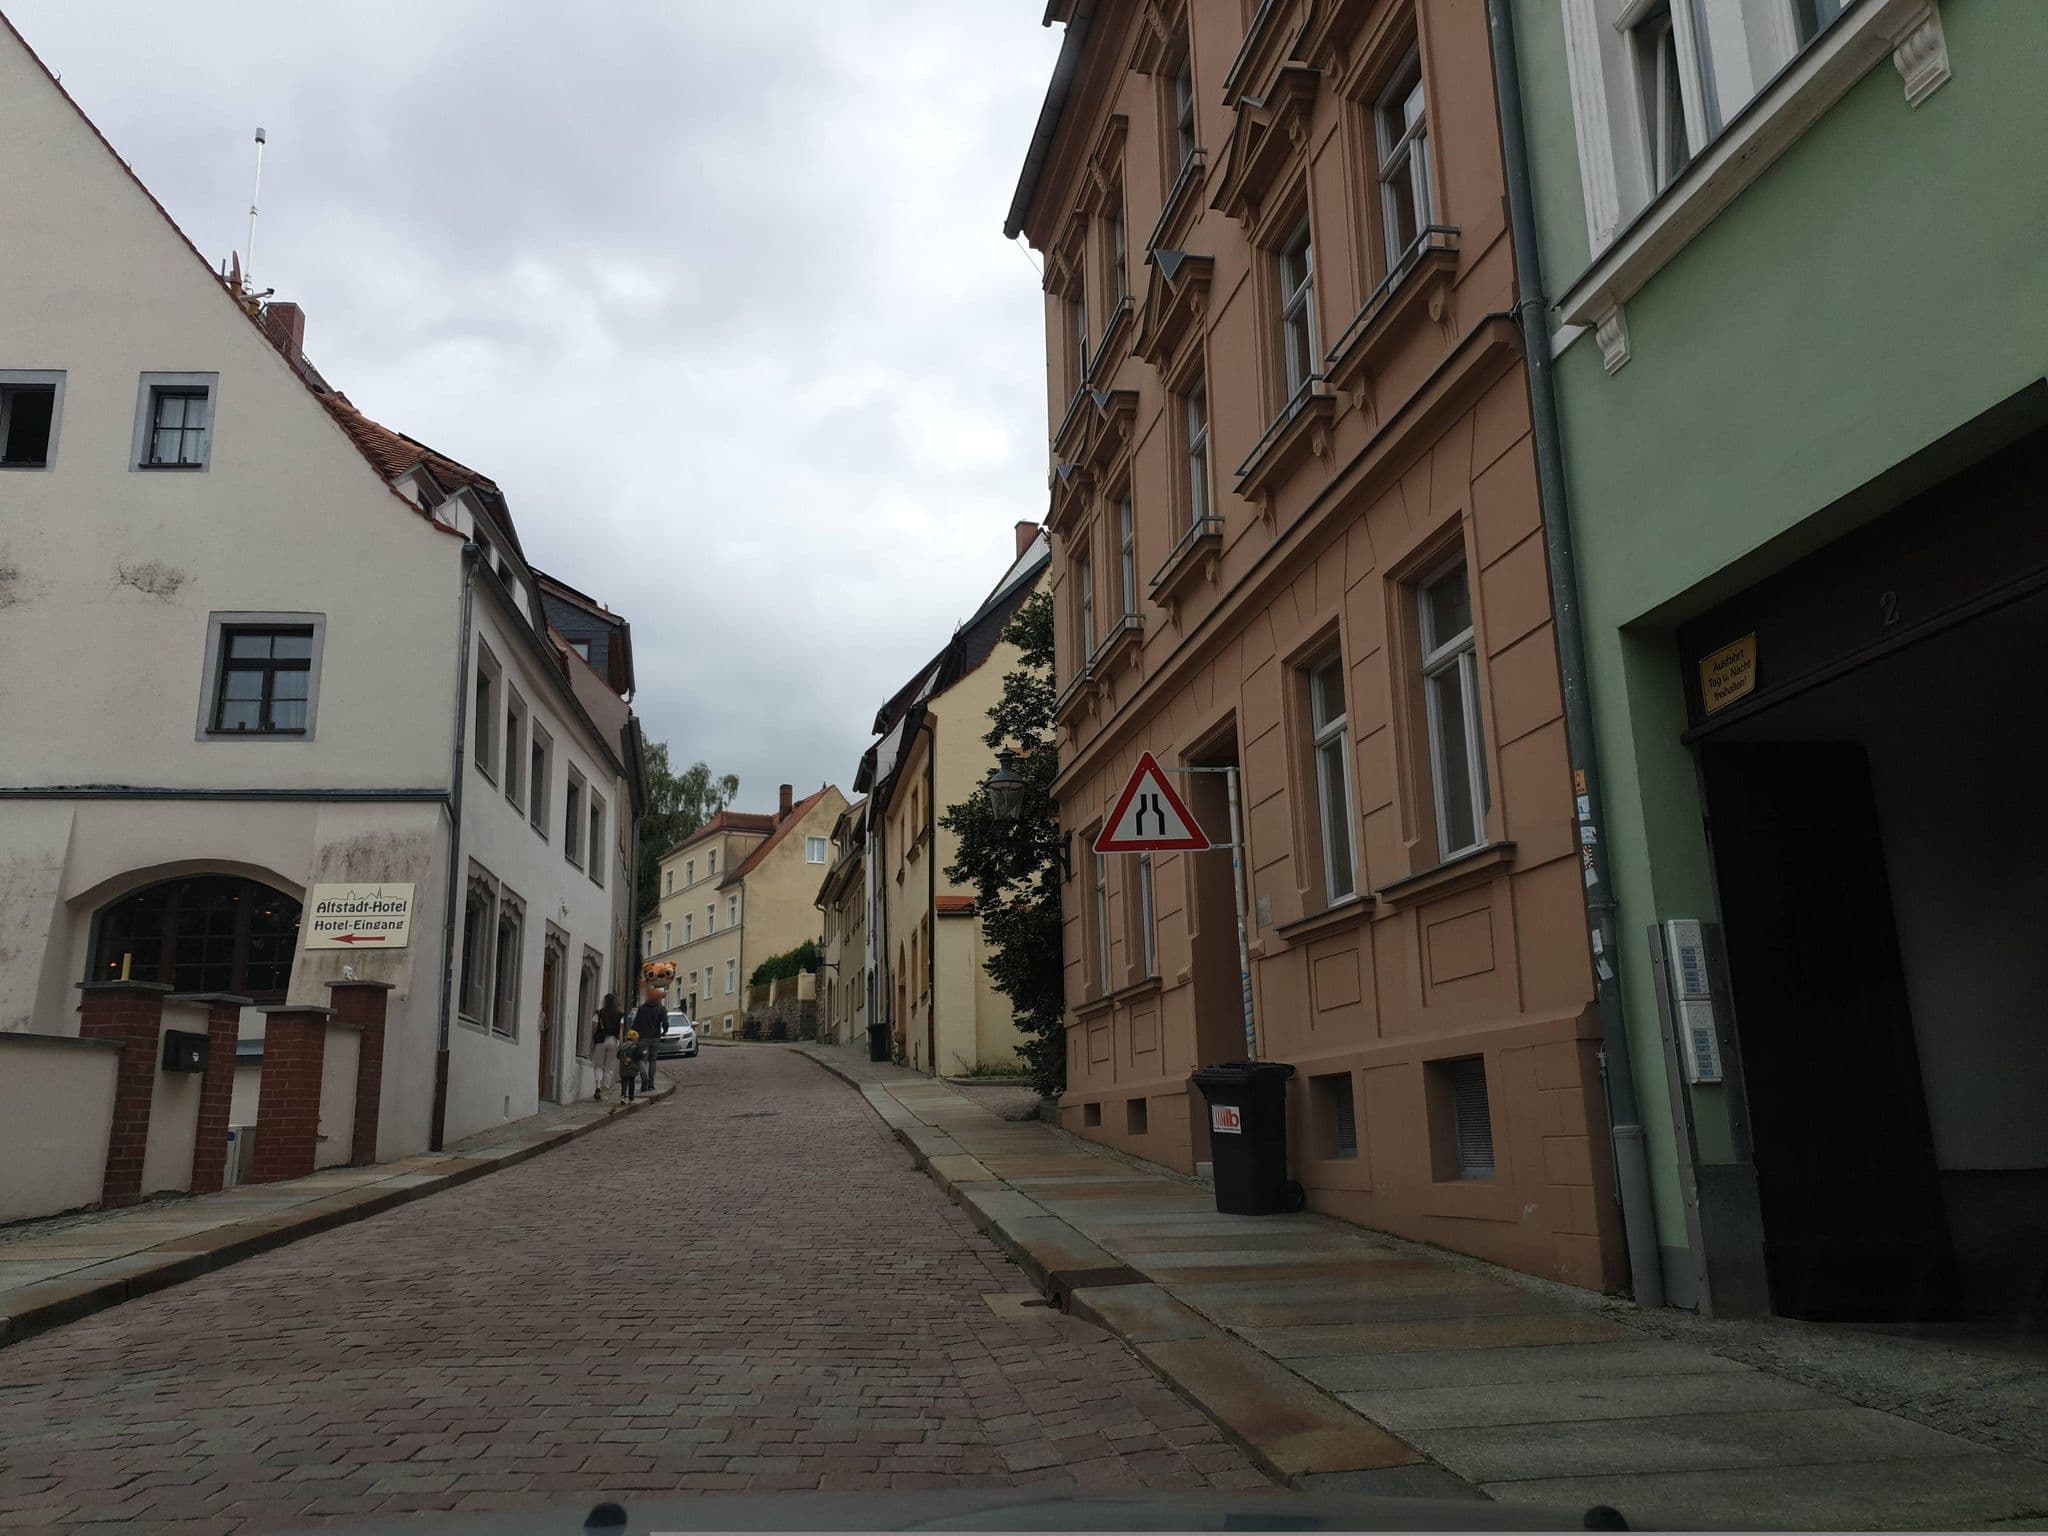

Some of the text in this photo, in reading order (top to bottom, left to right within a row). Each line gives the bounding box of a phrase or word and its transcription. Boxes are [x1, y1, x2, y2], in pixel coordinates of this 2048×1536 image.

[1880, 592, 1899, 626] 2
[1712, 649, 1744, 672] Ausfahrt
[1709, 660, 1751, 689] Tag u. Nacht
[316, 900, 407, 913] Altstadt-Hotel
[314, 919, 404, 931] Hotel-Eingang
